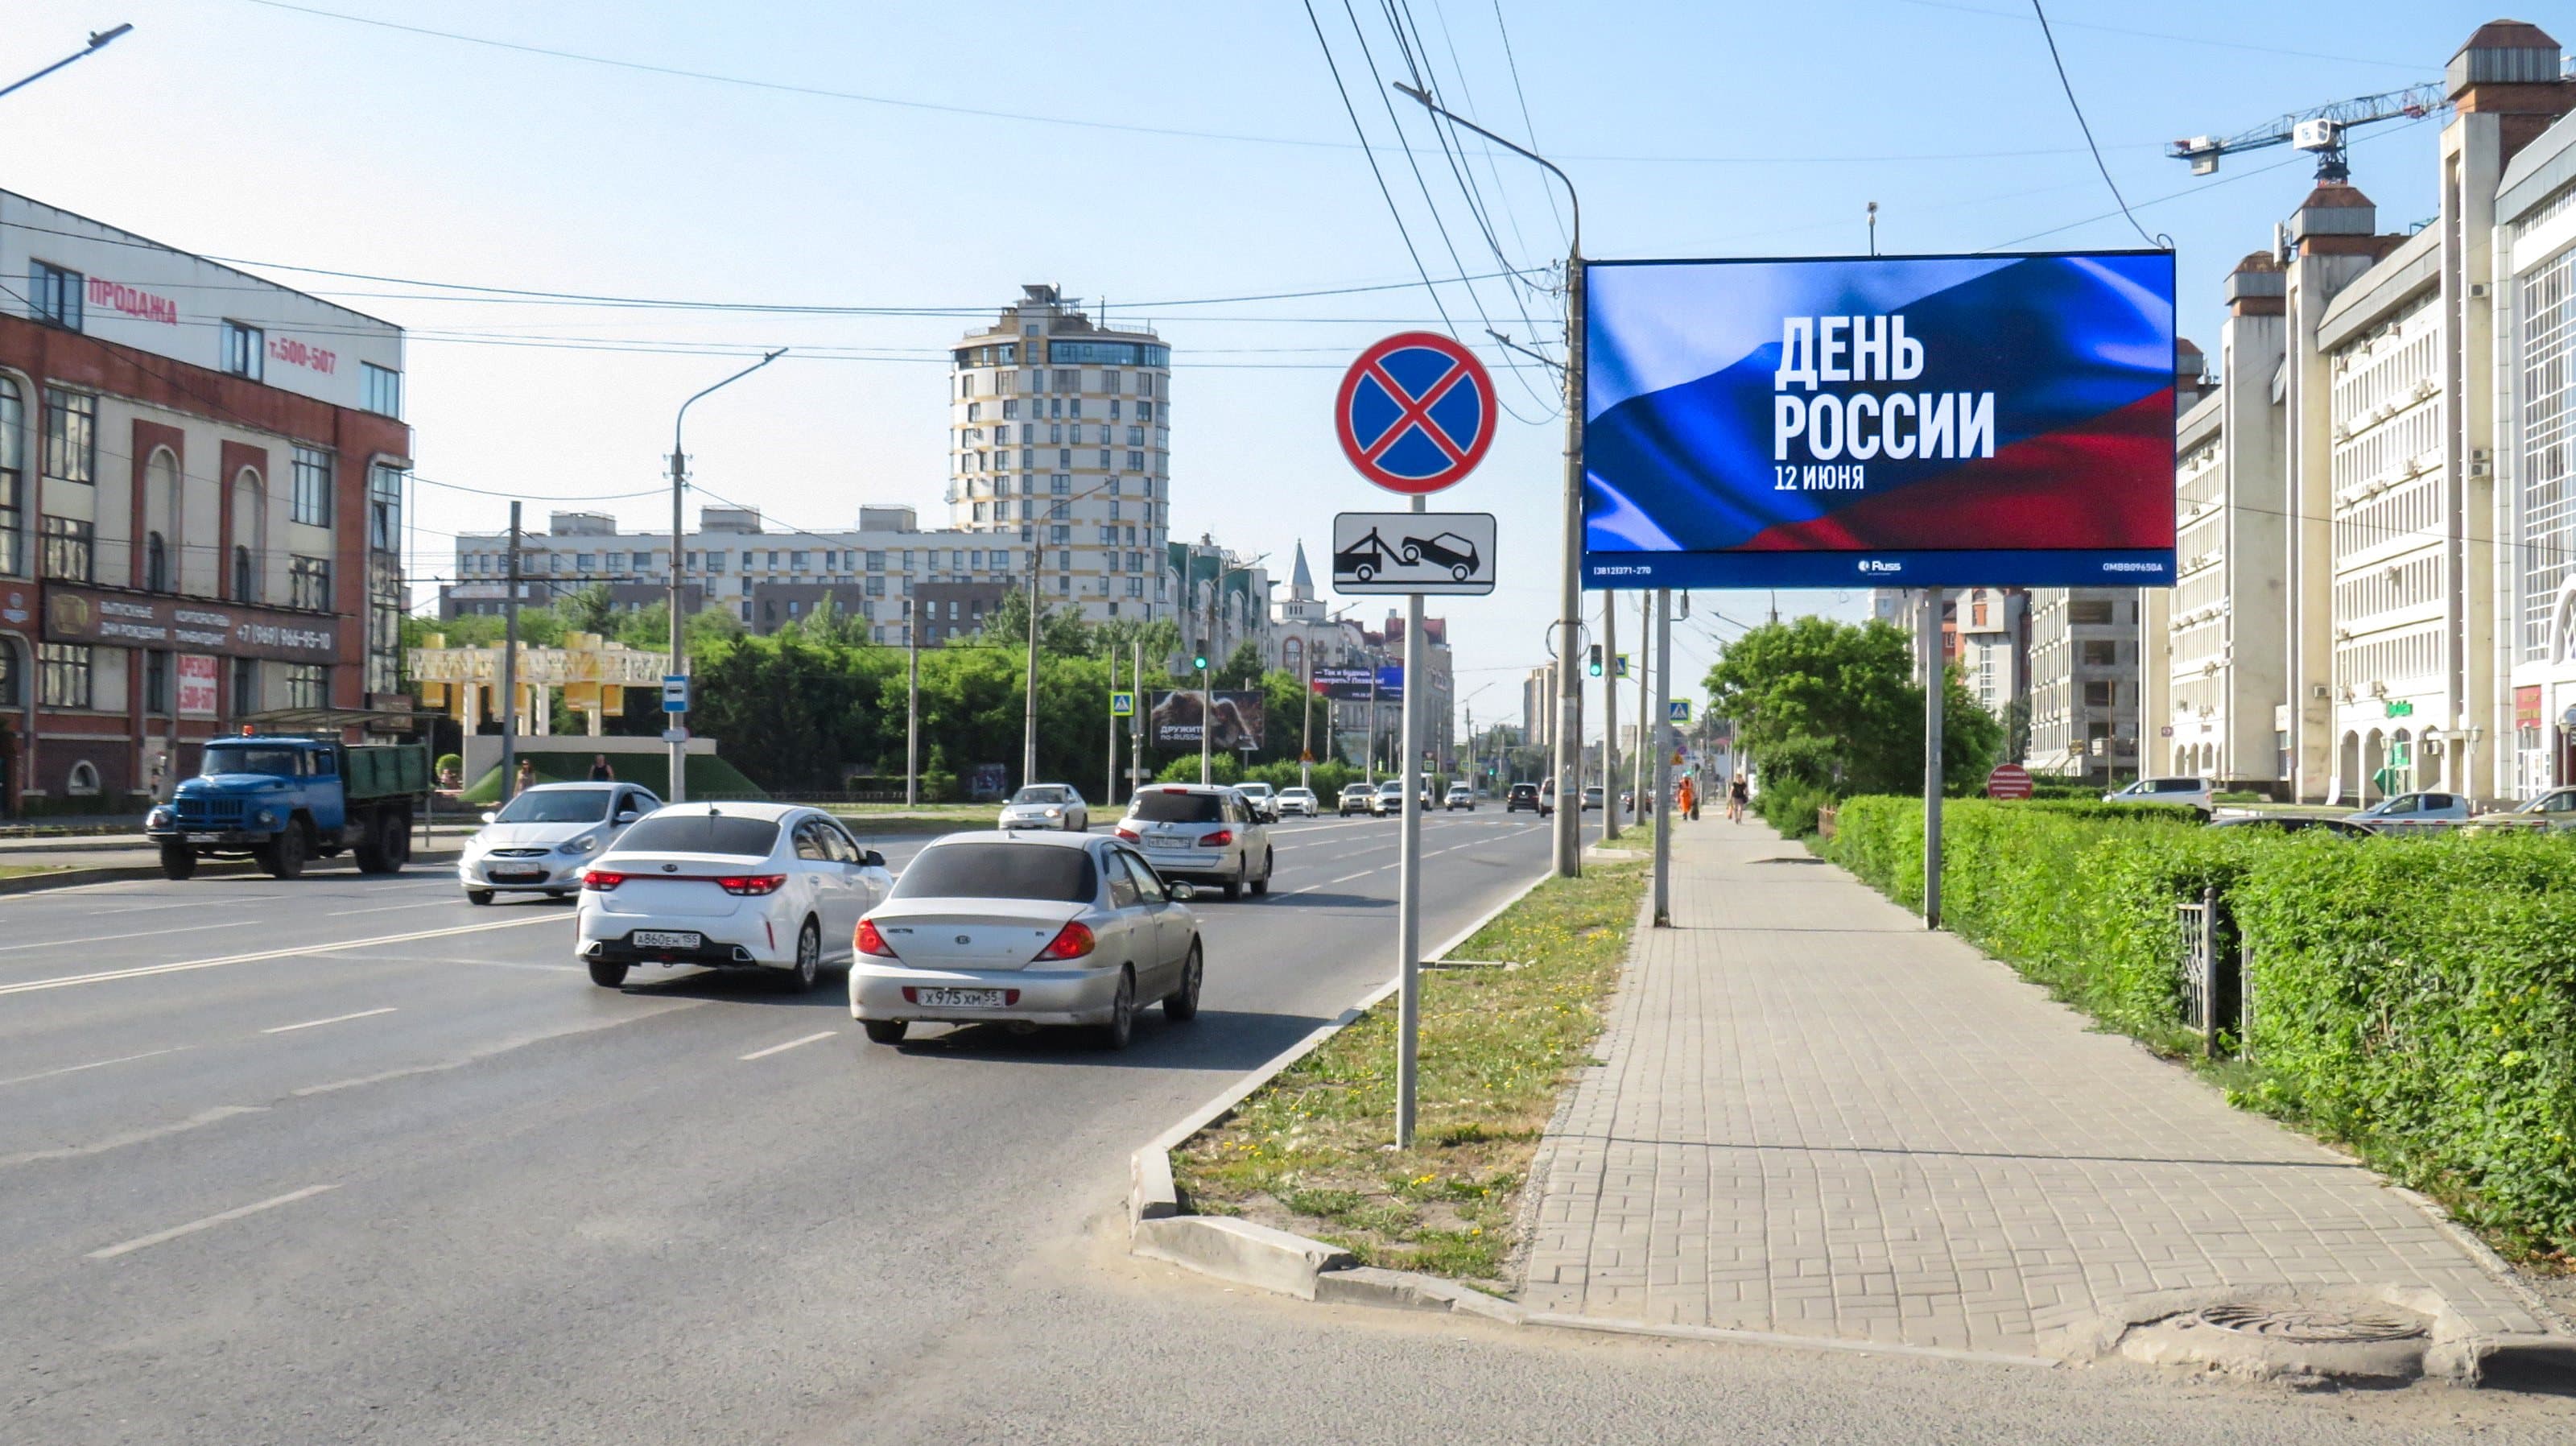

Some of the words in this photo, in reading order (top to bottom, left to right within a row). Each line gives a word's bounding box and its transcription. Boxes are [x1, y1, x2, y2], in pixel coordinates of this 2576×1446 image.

[89, 276, 178, 326] ПРОДАЖА
[1774, 315, 1924, 391] ДЕНЬ
[1774, 391, 1995, 461] РОССИИ
[1773, 465, 1798, 490] 12
[1802, 465, 1864, 490] ИЮНЯ
[1872, 560, 1901, 572] Russ
